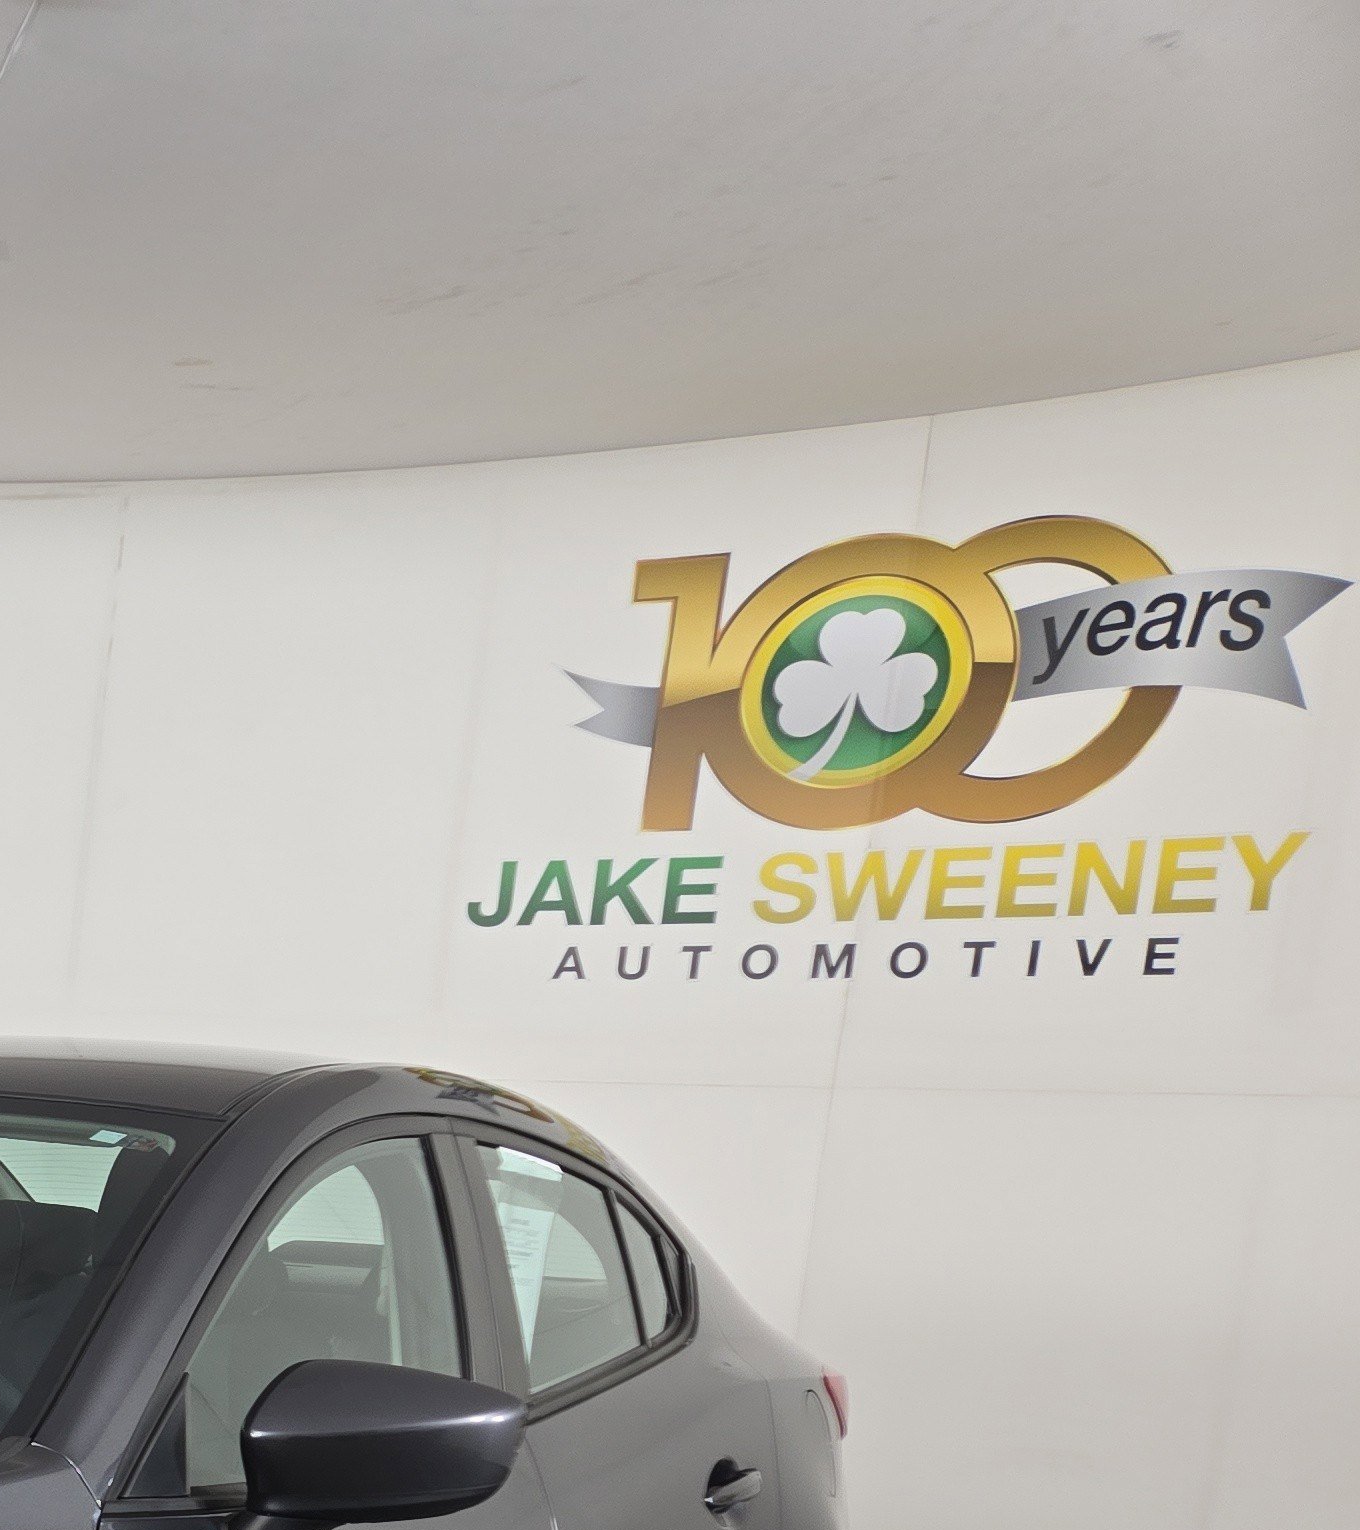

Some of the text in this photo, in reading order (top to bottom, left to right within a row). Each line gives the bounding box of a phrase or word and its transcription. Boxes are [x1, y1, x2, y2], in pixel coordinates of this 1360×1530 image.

[633, 513, 1273, 833] 100 years
[466, 830, 1312, 929] JAKE SWEENEY
[551, 935, 1182, 982] AUTOMOTIVE
